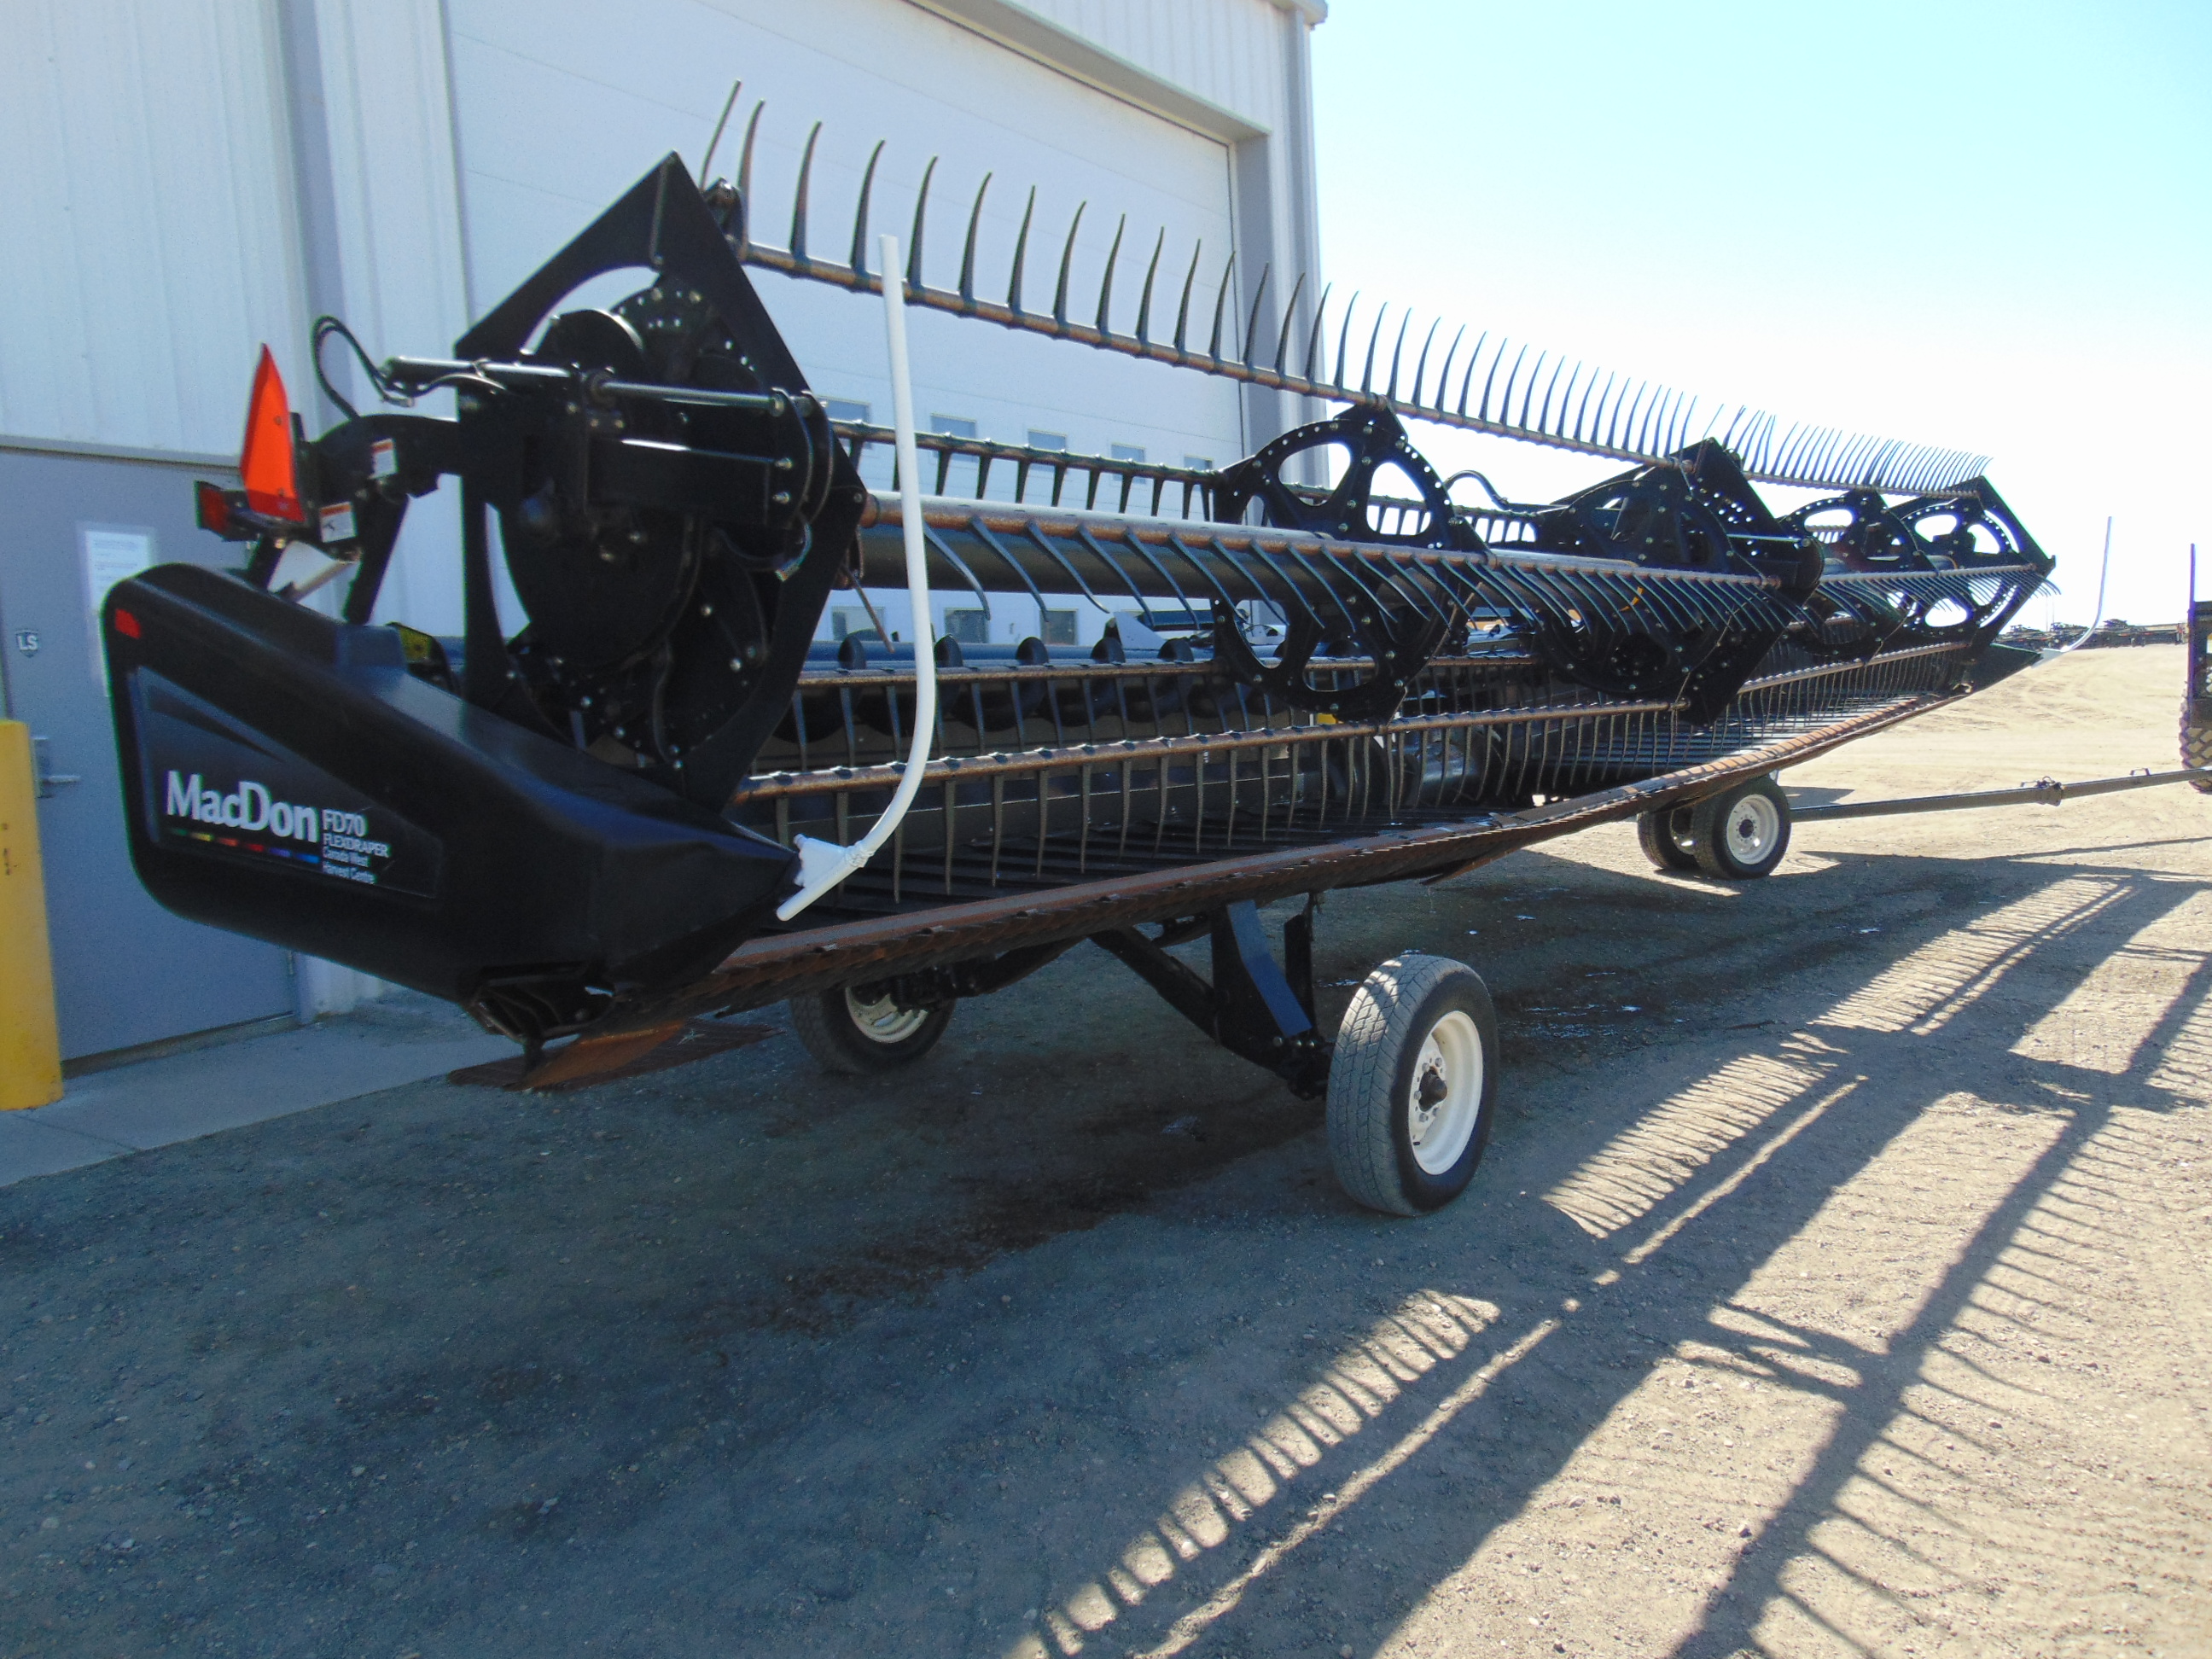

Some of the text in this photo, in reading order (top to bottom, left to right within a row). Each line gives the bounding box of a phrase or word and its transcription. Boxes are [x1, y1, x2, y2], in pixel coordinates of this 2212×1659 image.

[18, 635, 38, 650] LS
[166, 770, 319, 843] MacDon
[323, 809, 368, 837] FD70
